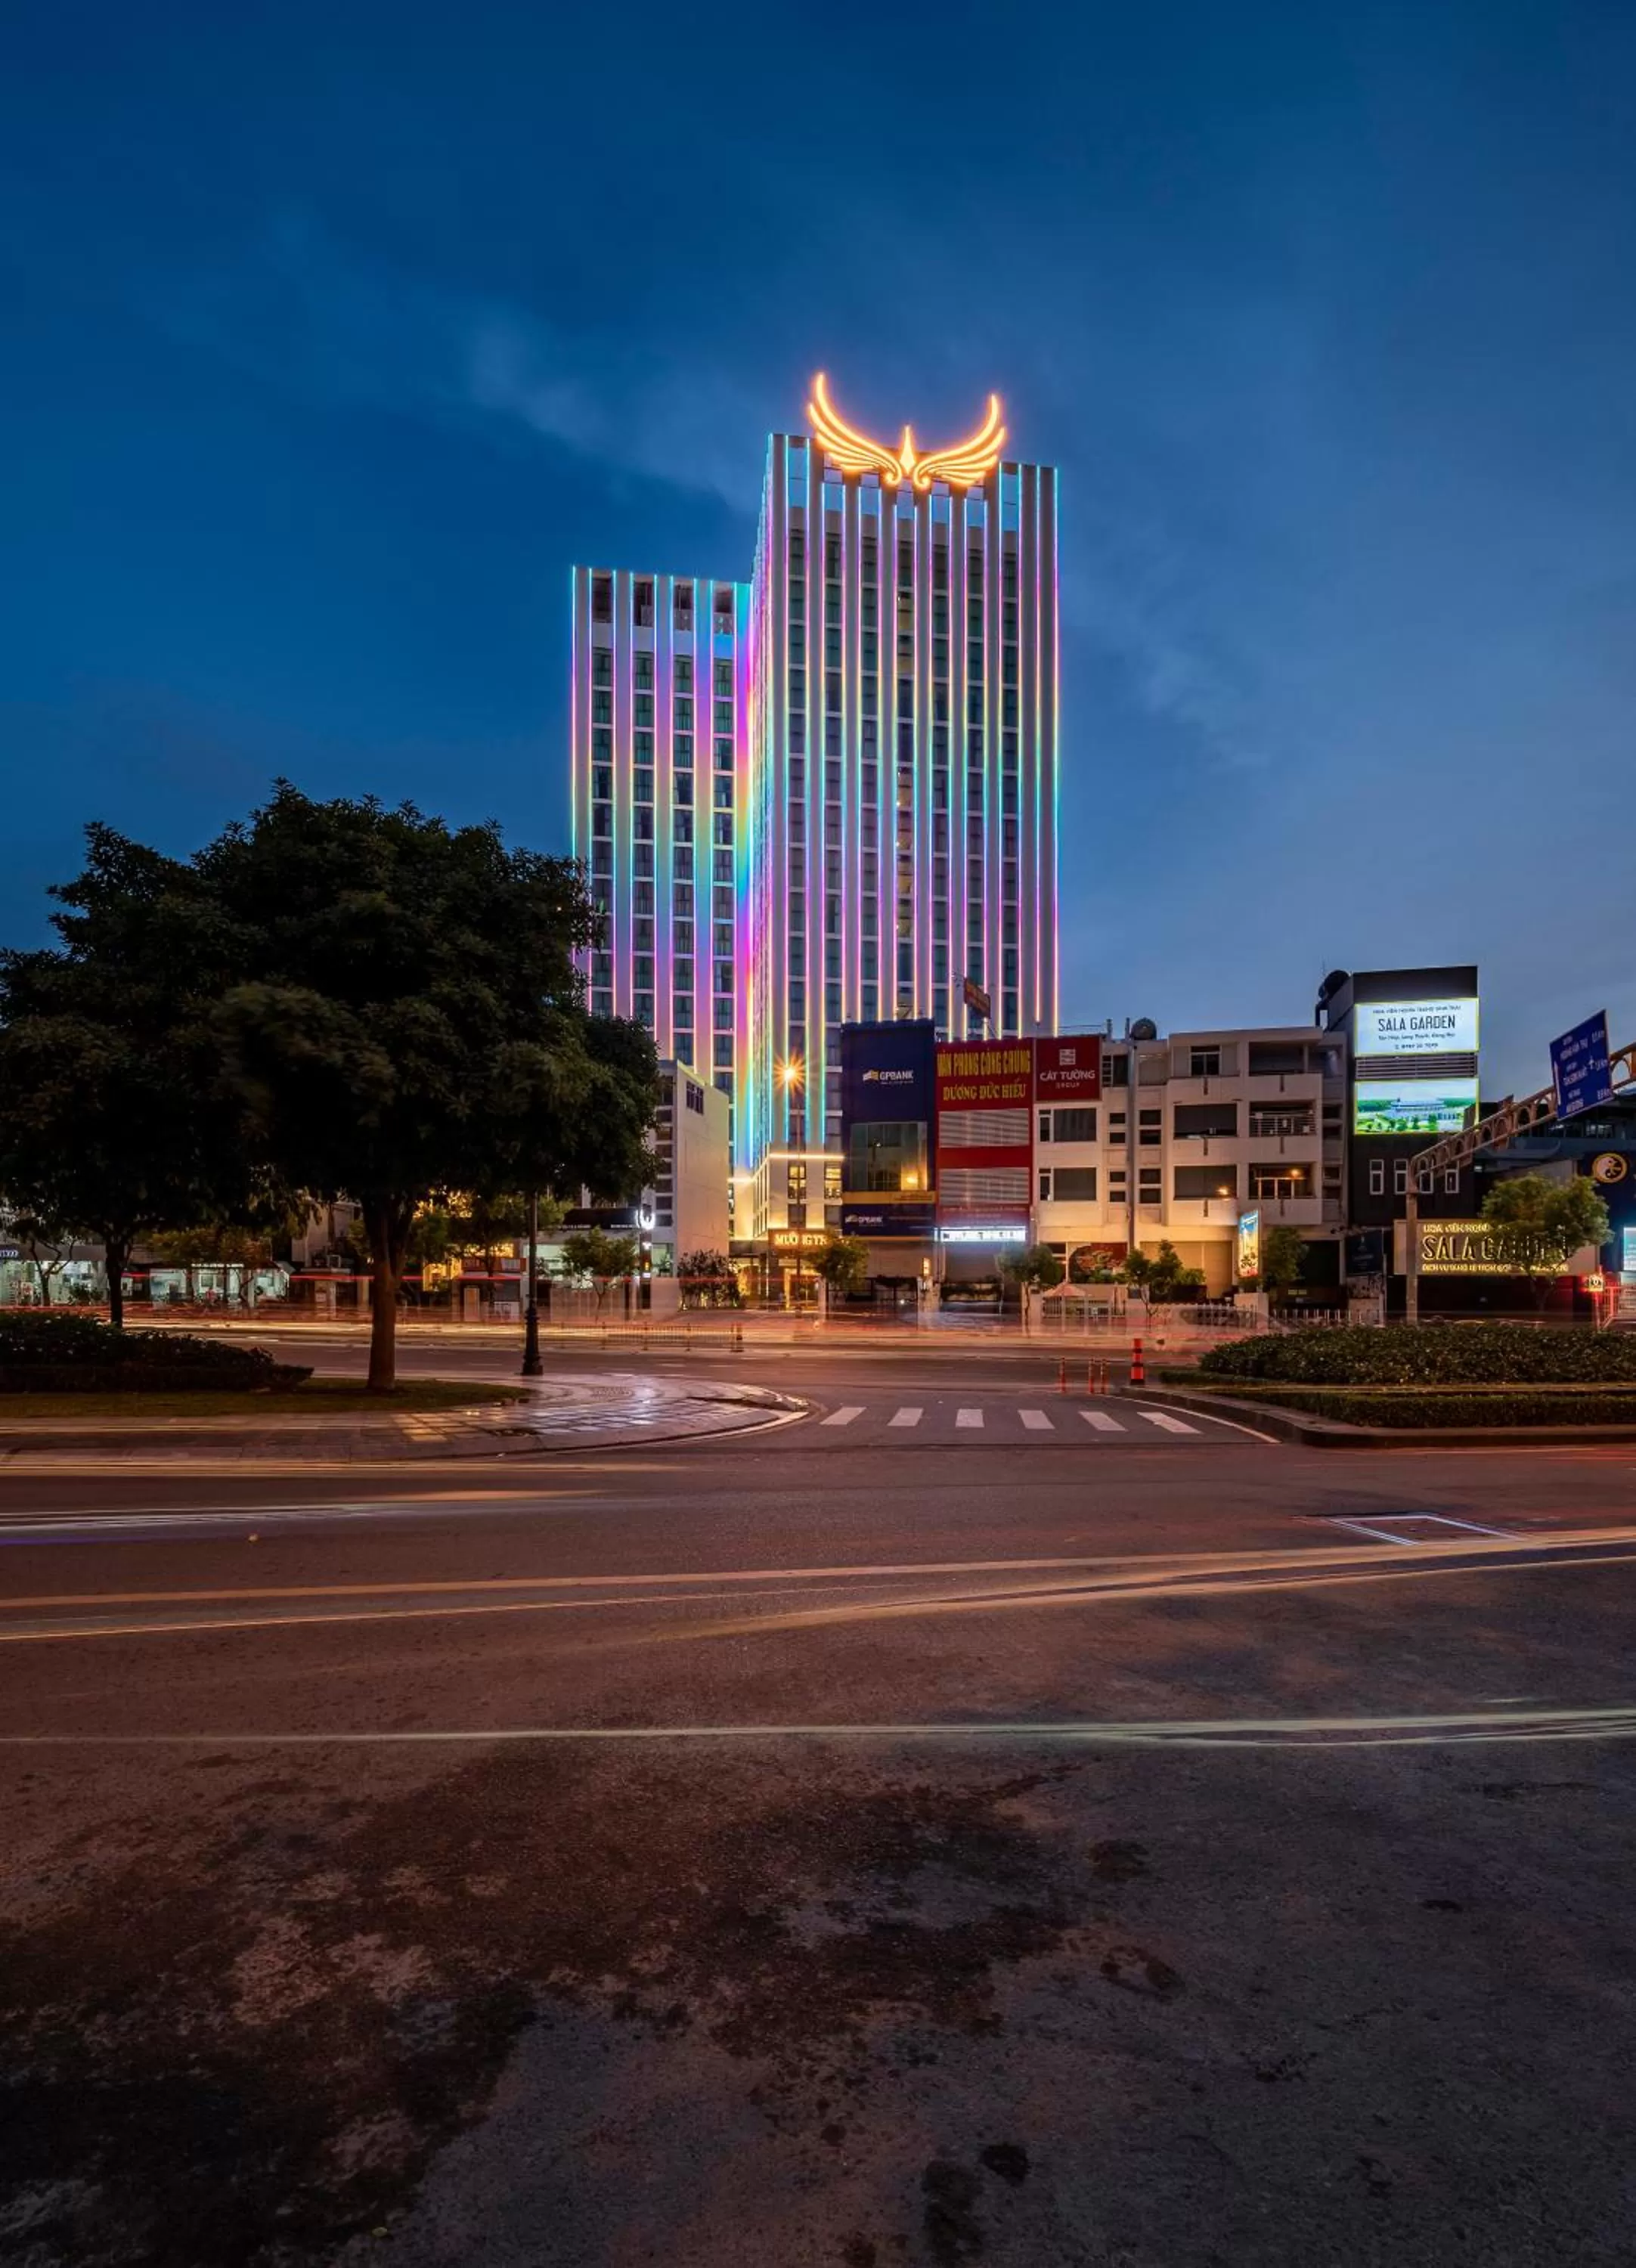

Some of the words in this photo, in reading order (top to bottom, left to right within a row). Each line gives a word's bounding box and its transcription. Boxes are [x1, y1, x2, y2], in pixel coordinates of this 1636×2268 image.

[1378, 1017, 1406, 1032] SALA
[1410, 1014, 1456, 1030] GARDEN
[879, 1070, 914, 1080] GPBANK
[1422, 1235, 1475, 1261] SALA
